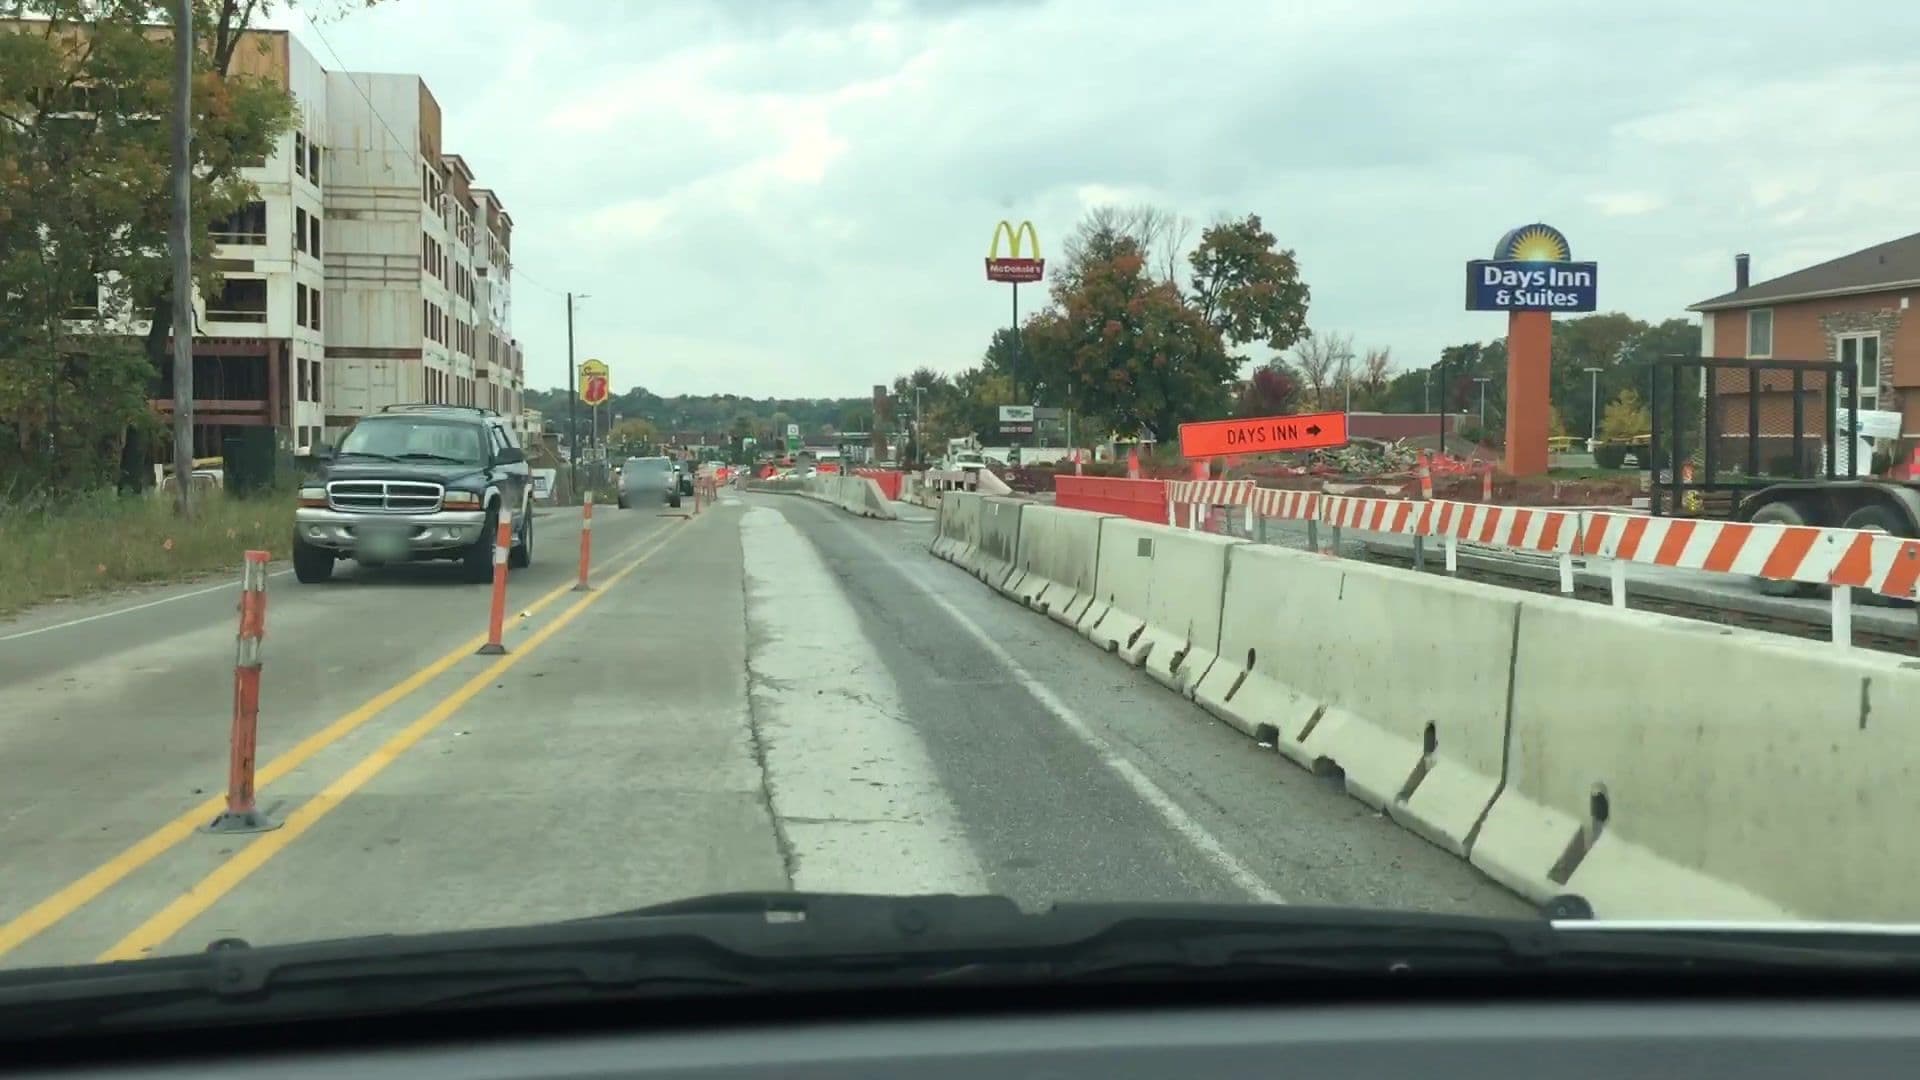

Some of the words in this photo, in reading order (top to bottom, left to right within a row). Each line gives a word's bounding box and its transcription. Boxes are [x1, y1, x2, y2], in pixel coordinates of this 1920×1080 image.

[1484, 266, 1545, 288] Days
[1549, 267, 1590, 287] Inn
[1495, 290, 1510, 305] &
[1514, 289, 1578, 306] Suites
[1227, 427, 1266, 445] DAYS
[1272, 425, 1298, 440] INN
